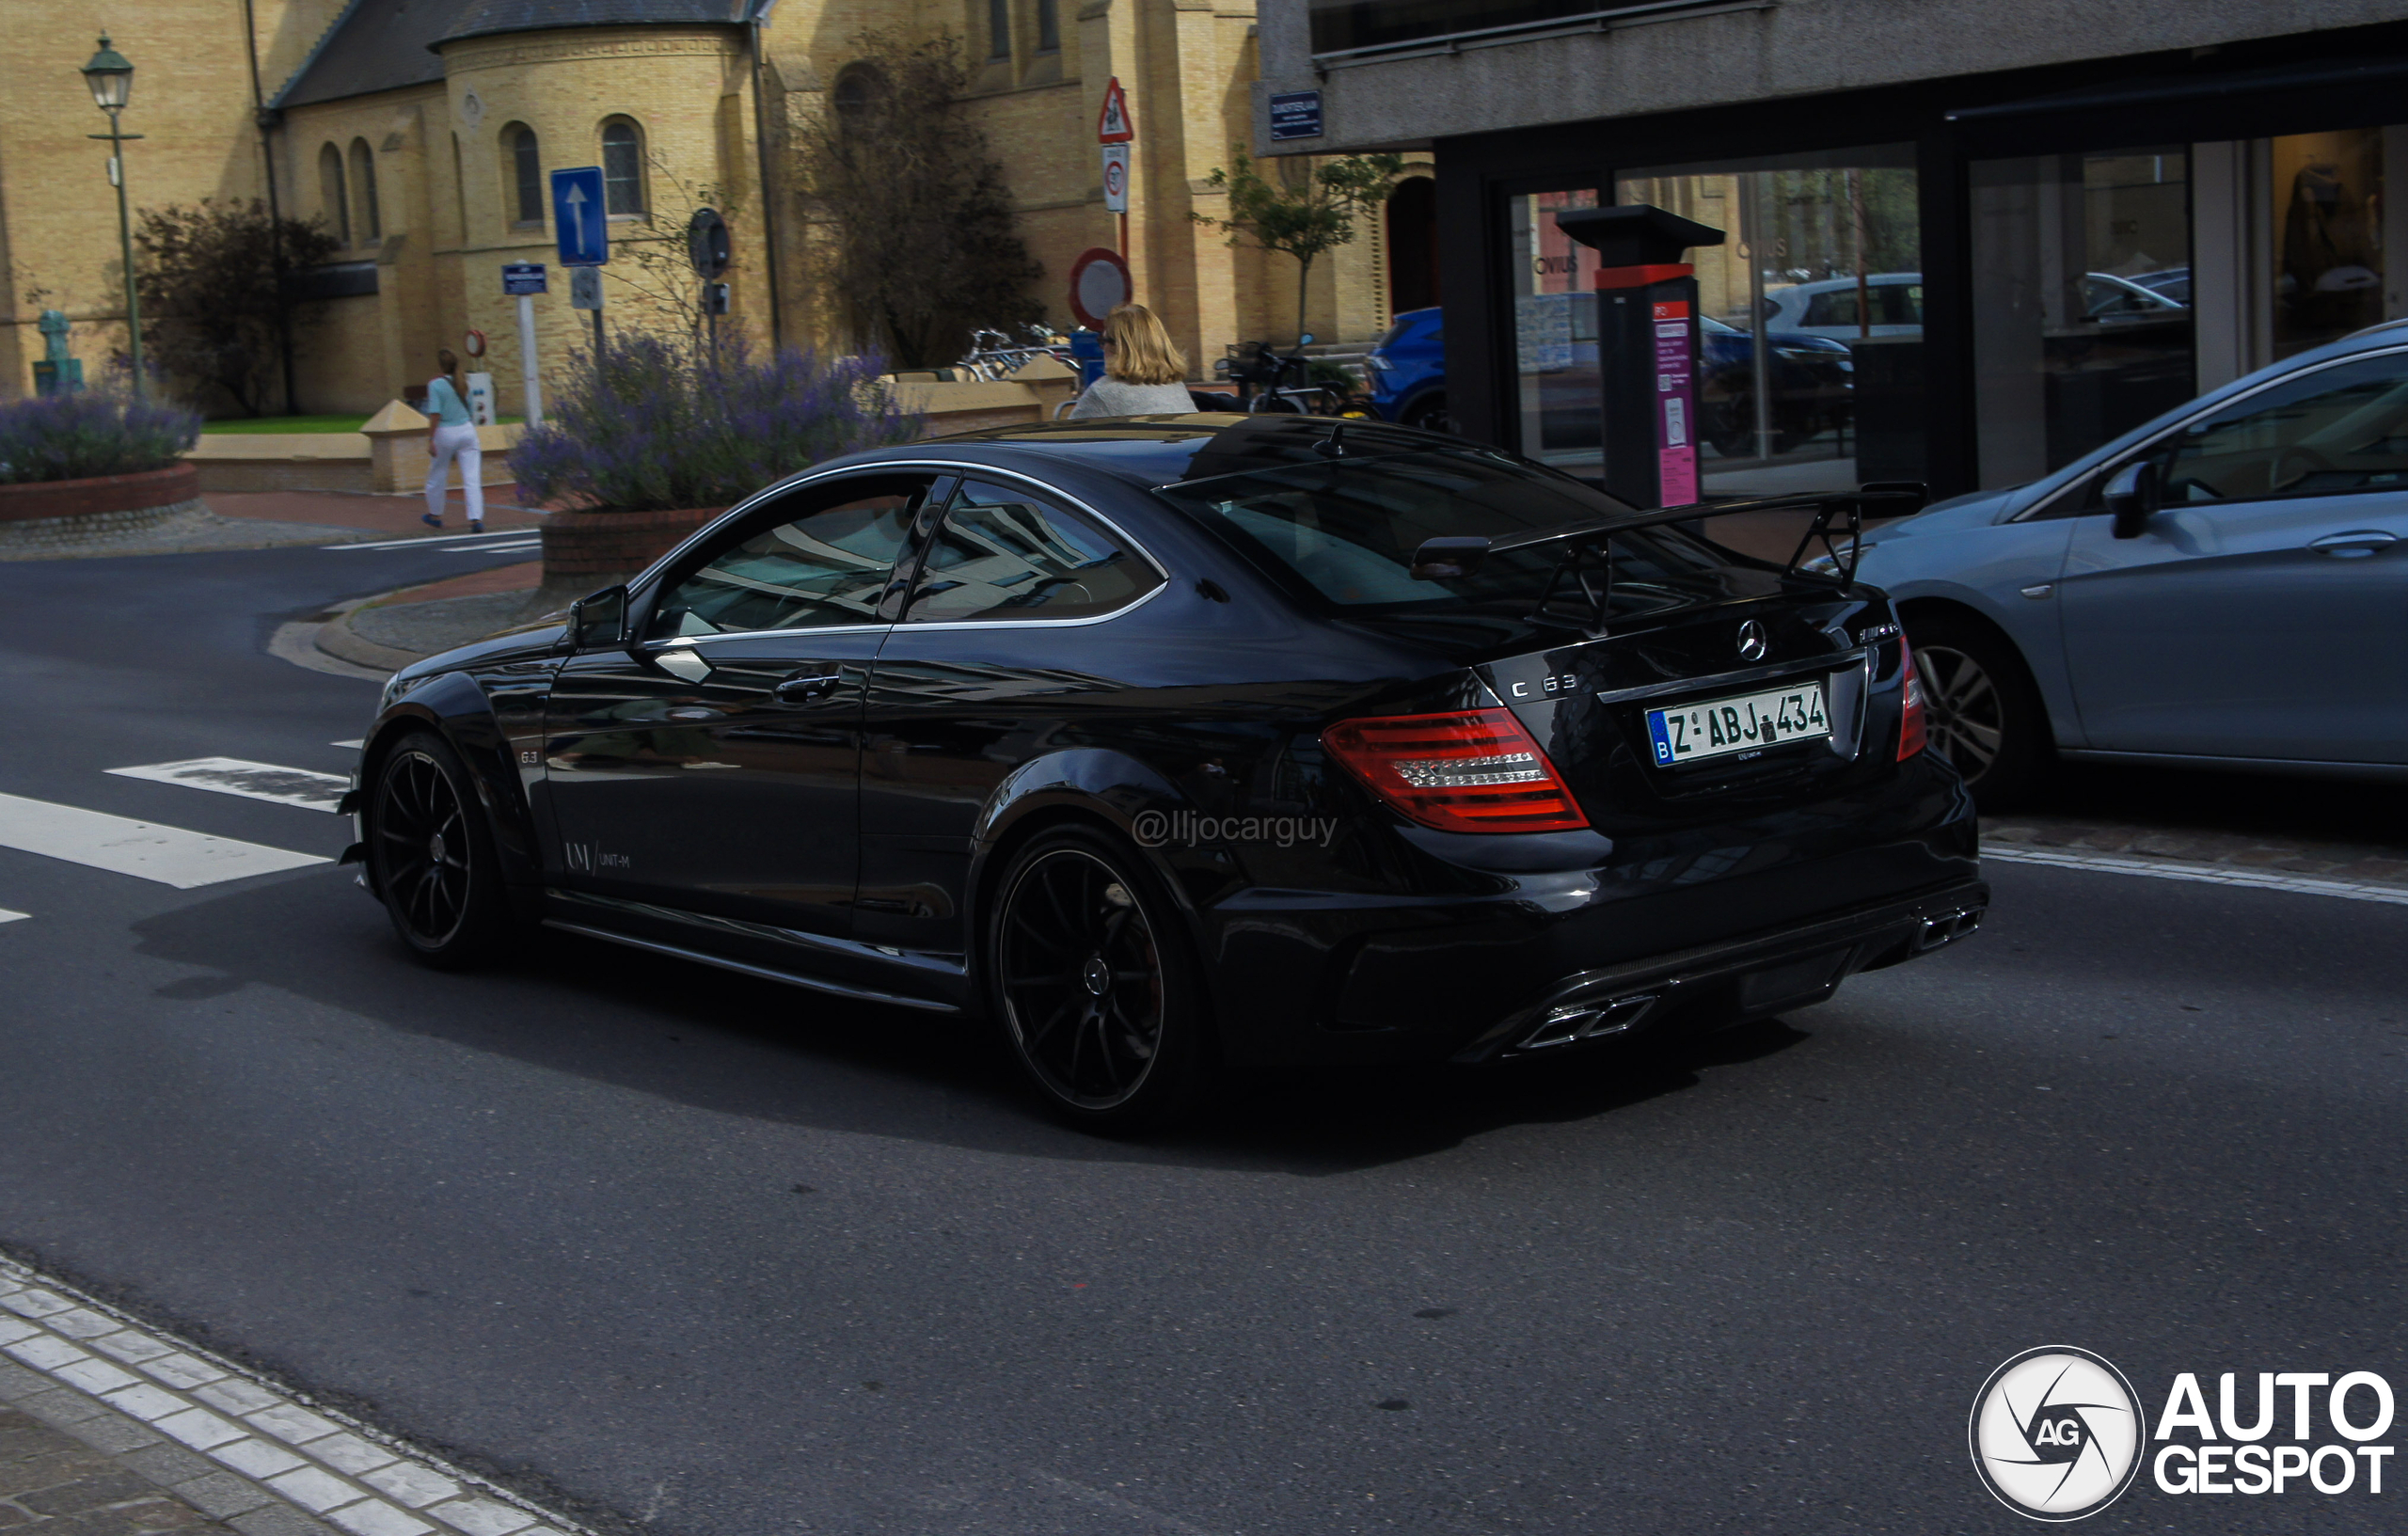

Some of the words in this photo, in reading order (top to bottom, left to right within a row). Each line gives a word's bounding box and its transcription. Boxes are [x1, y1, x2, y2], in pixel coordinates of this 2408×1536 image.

[1512, 682, 1529, 698] C
[1543, 674, 1577, 692] 63
[520, 751, 538, 764] 63
[1657, 742, 1669, 759] B
